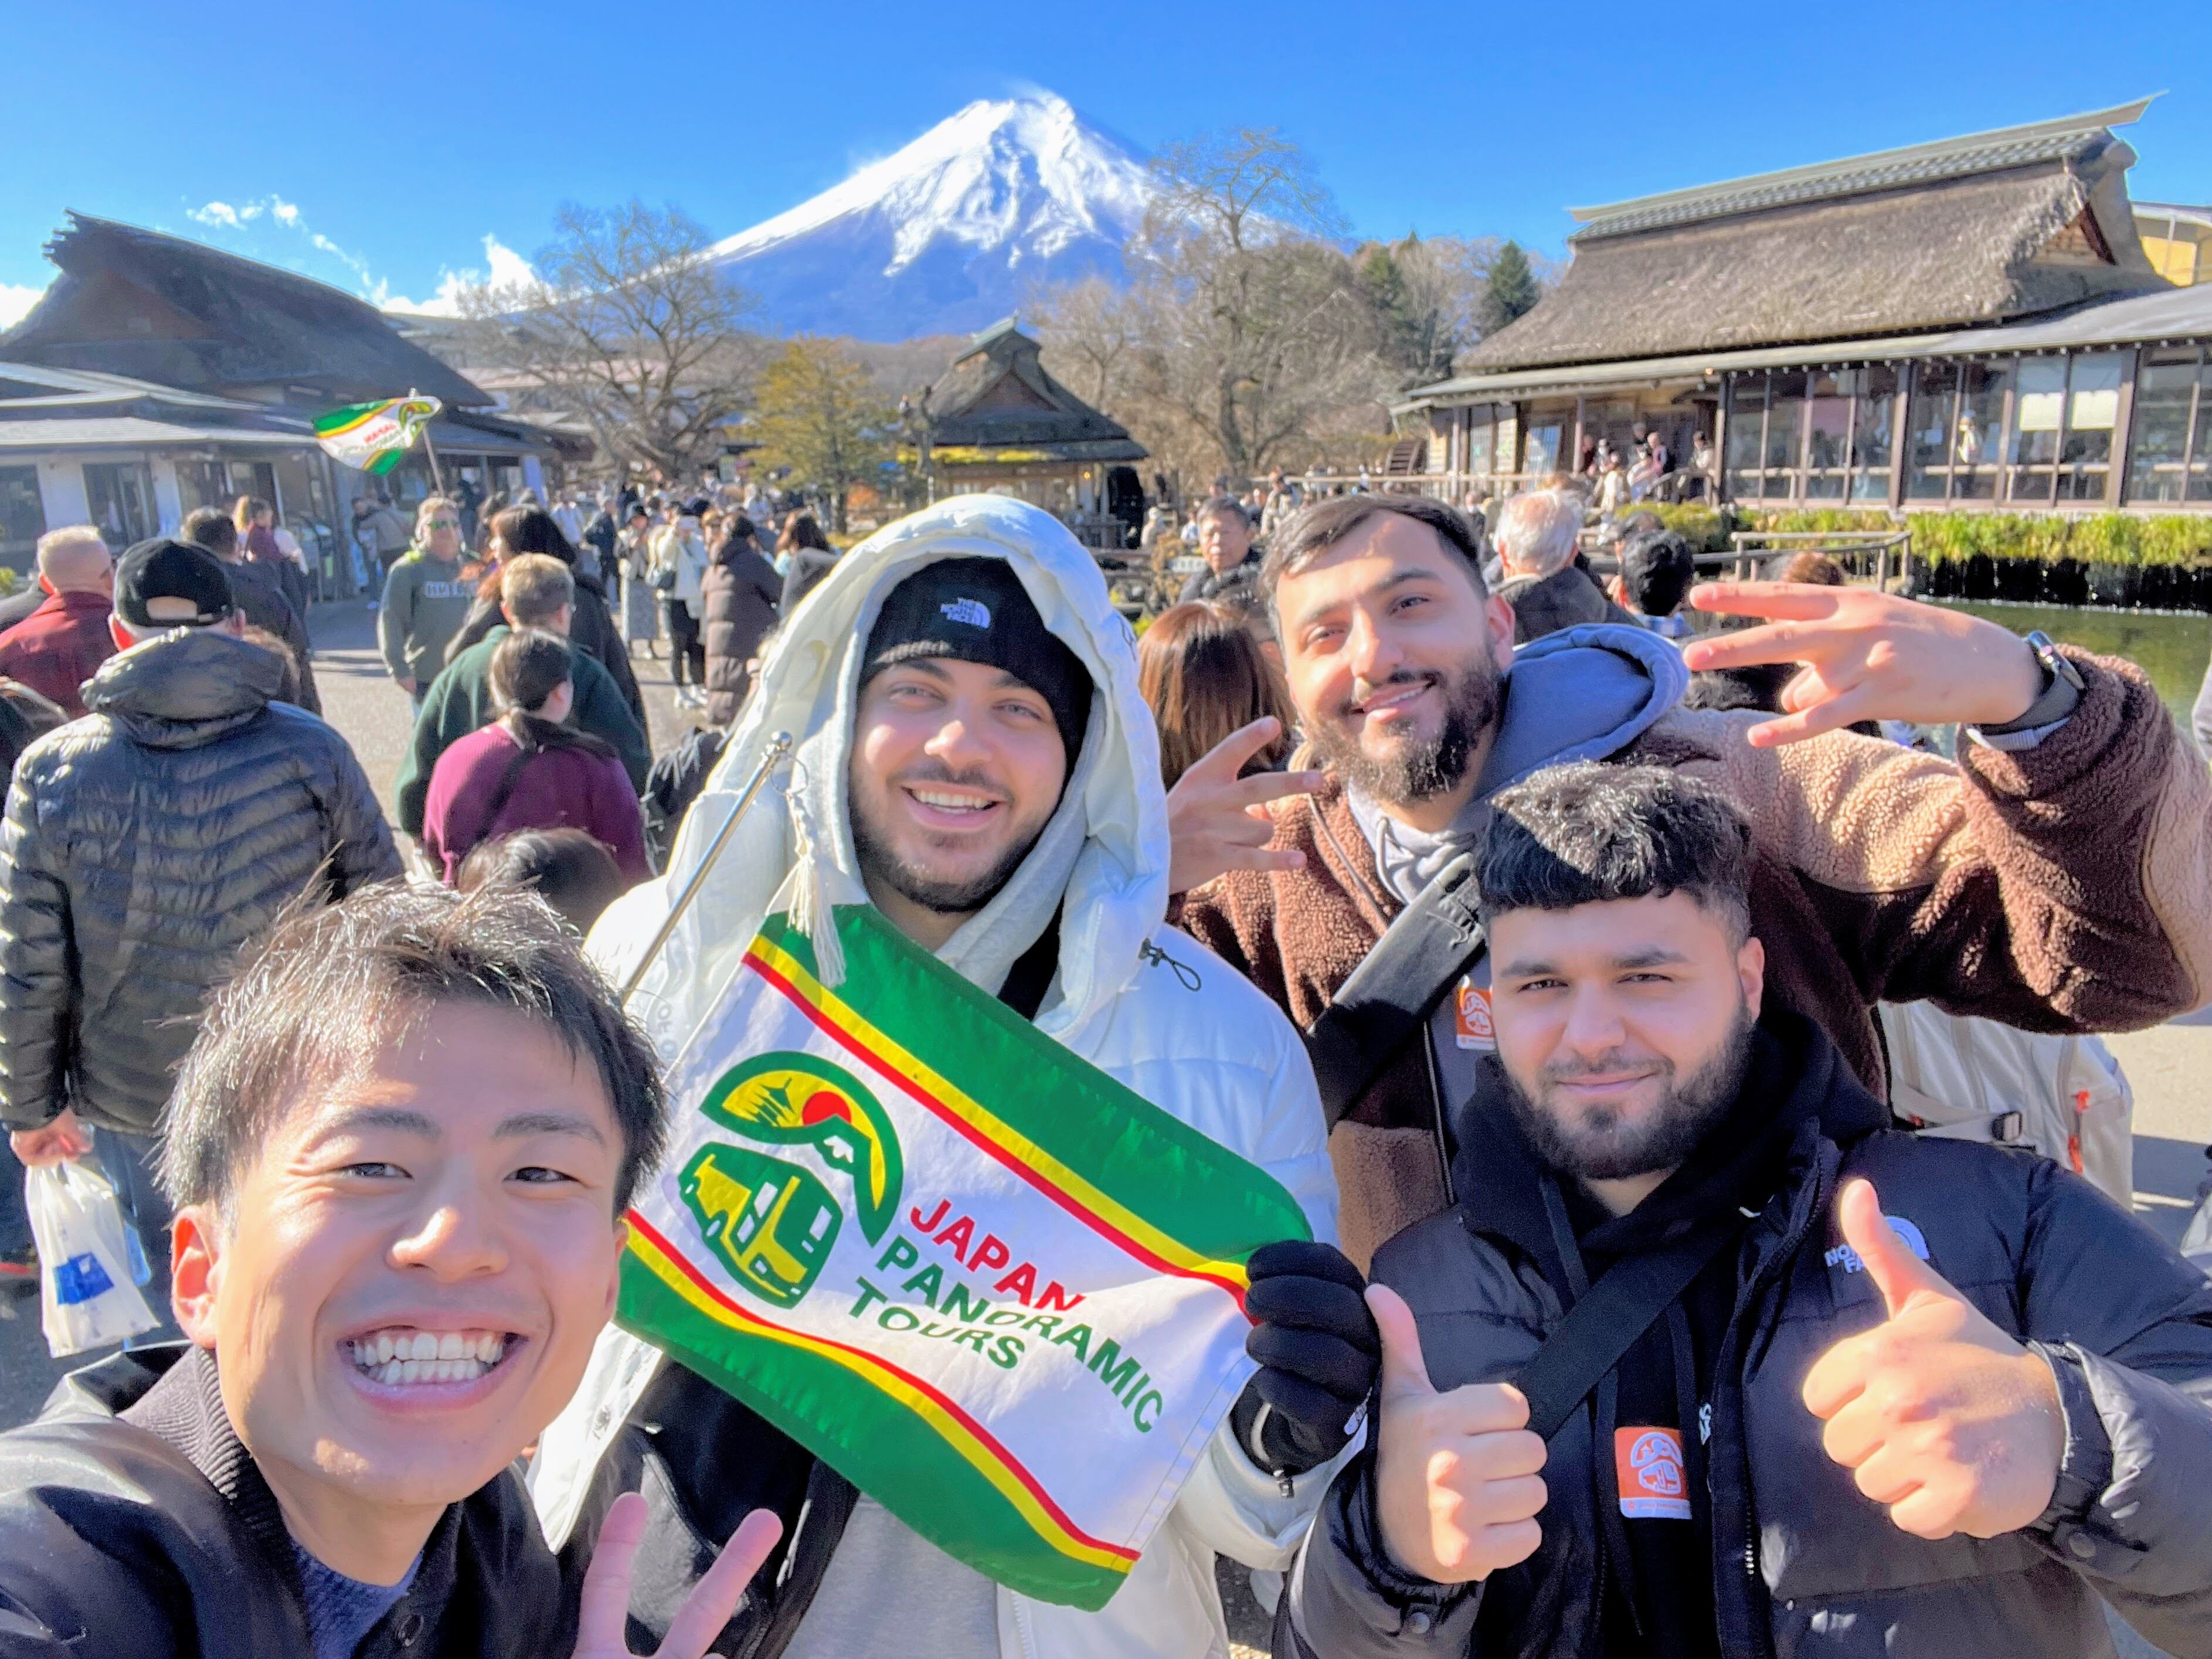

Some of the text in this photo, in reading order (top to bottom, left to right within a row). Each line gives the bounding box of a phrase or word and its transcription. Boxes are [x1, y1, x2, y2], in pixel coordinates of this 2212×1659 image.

[909, 1198, 1087, 1311] JAPAN
[847, 1276, 1025, 1369] TOURS
[875, 1234, 1163, 1433] PANORAMIC
